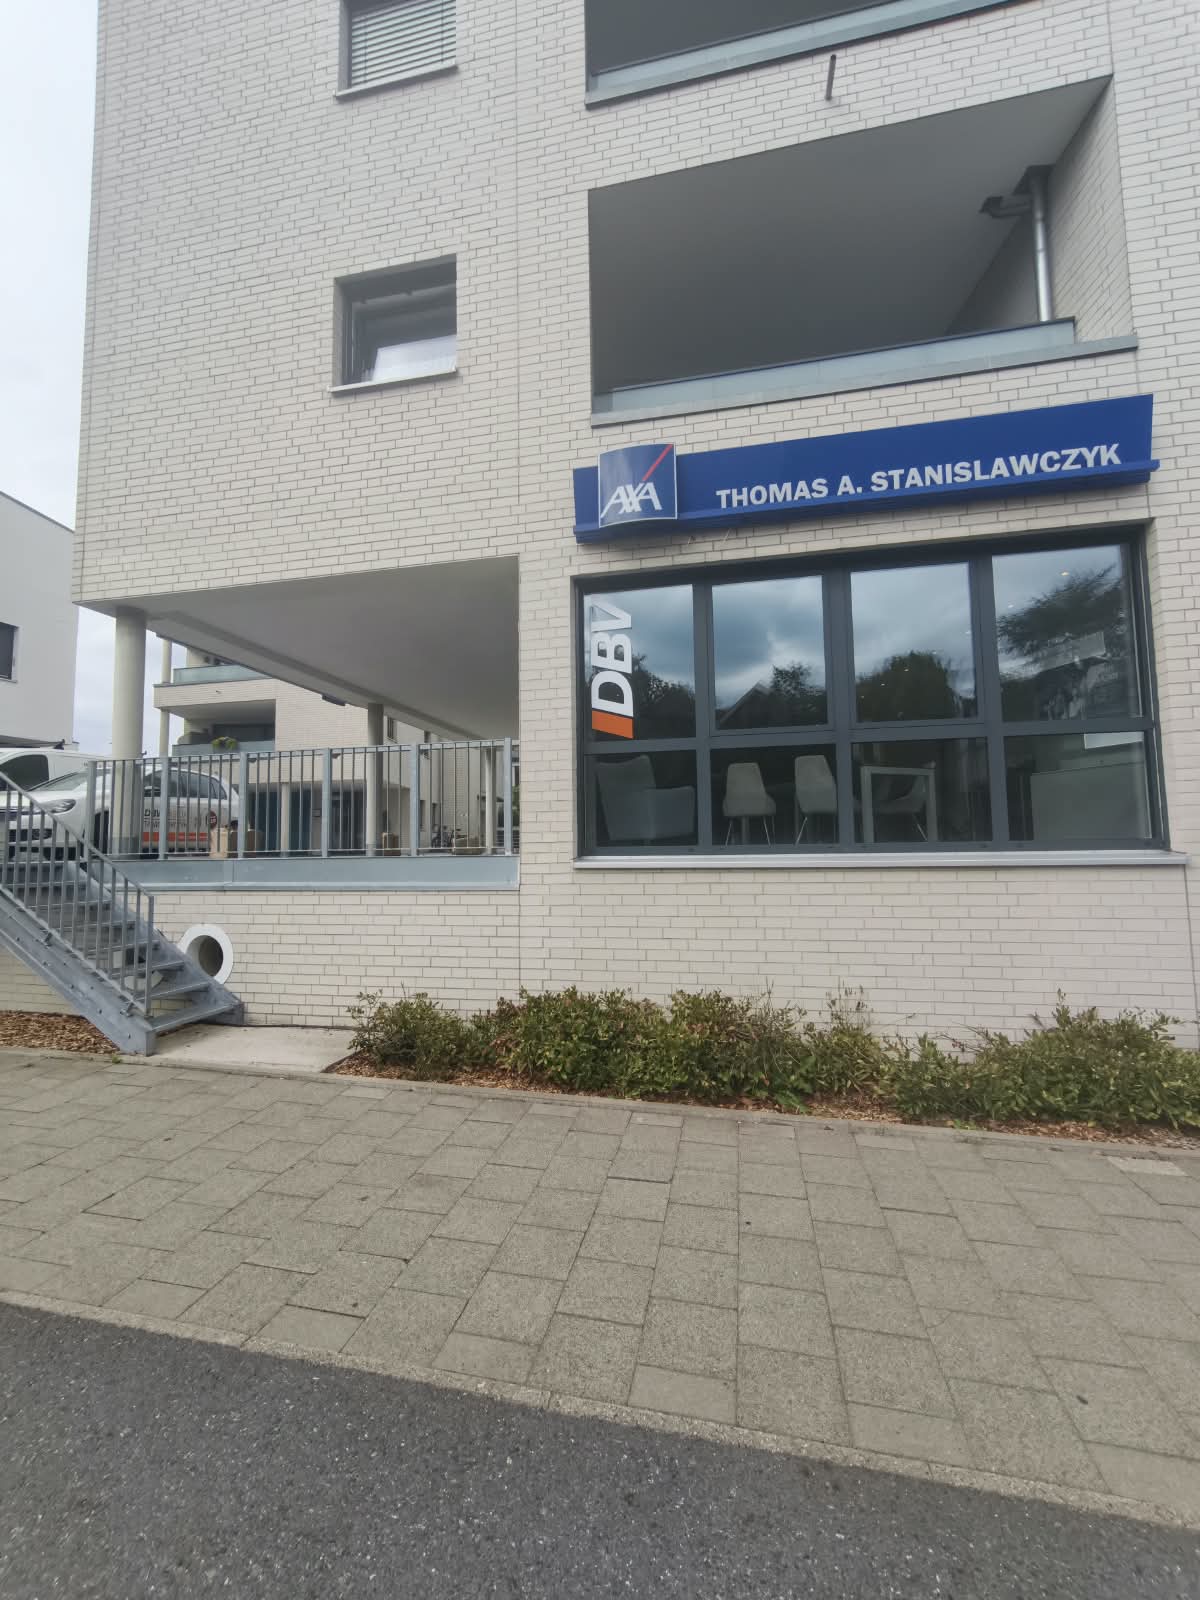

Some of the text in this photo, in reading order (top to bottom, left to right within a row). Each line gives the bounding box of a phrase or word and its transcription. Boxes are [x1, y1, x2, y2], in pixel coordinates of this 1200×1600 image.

[600, 482, 662, 518] AXA
[716, 443, 1121, 509] THOMAS A. STANISLAWCZYK
[591, 596, 633, 717] DBV
